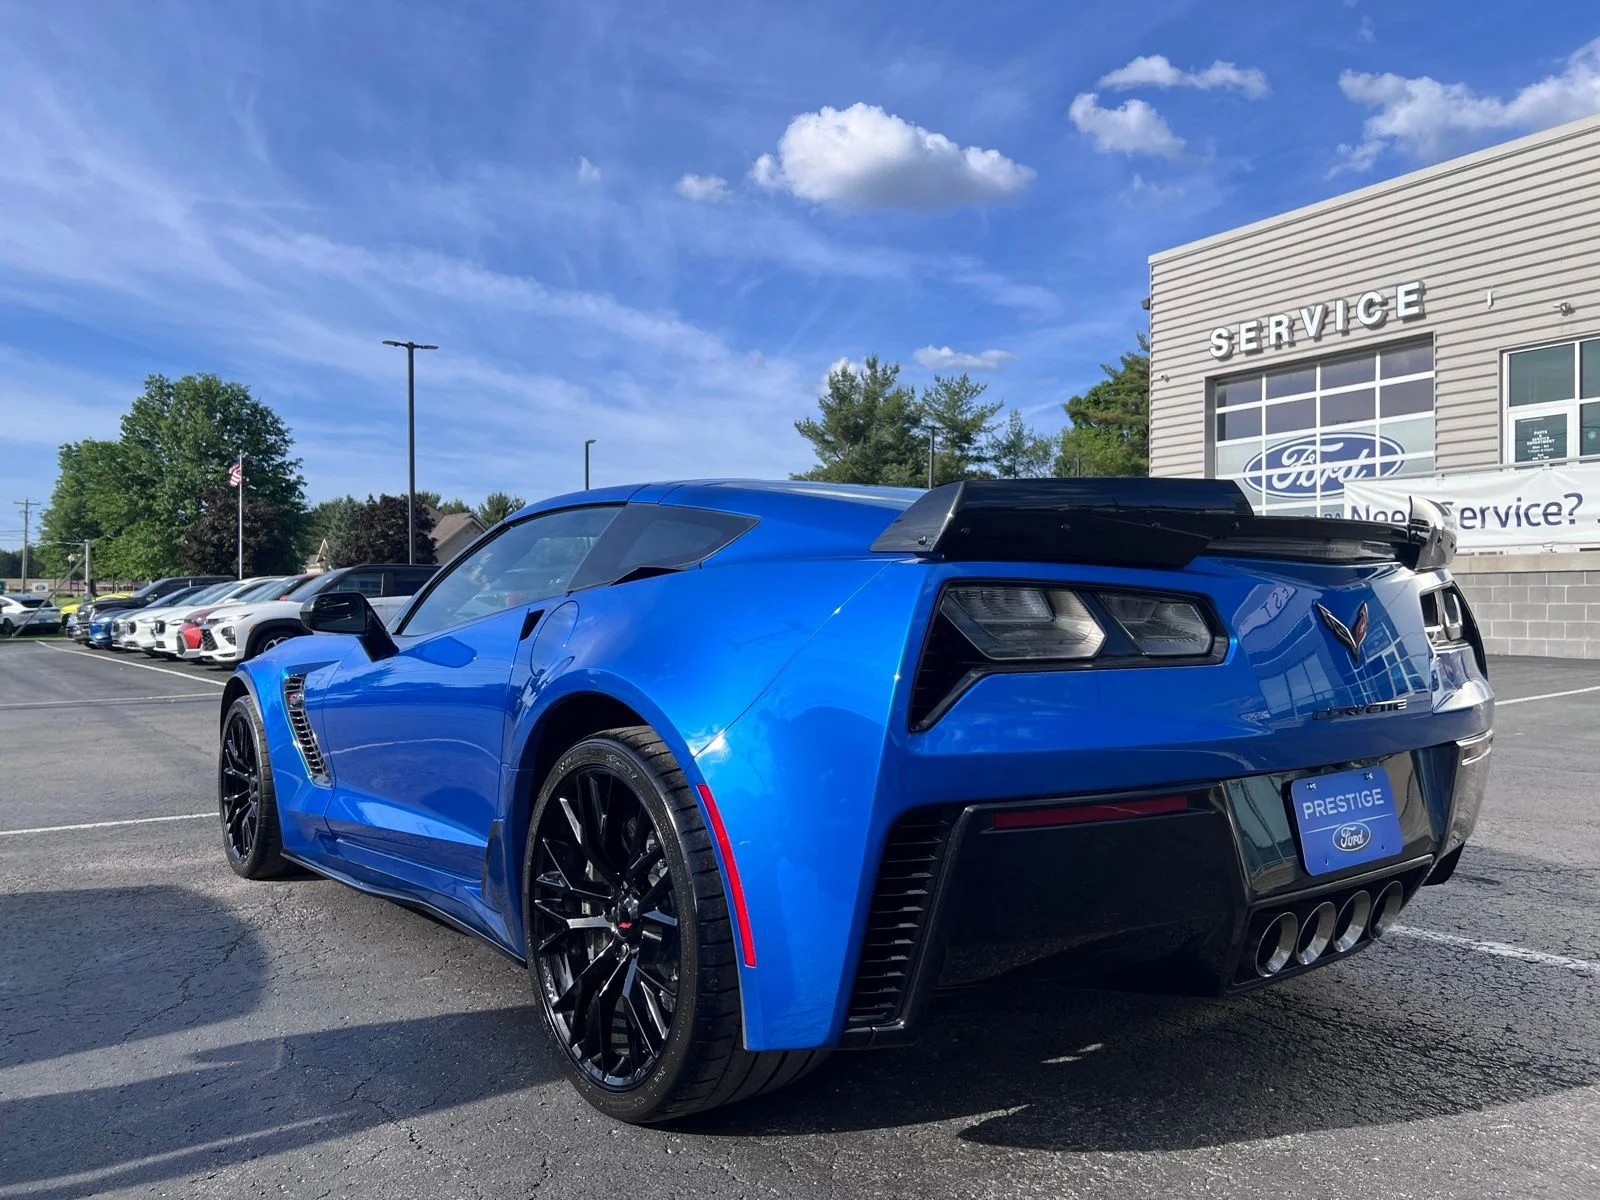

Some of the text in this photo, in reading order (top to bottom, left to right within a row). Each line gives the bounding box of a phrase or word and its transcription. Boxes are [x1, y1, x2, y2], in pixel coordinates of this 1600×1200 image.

[1209, 280, 1426, 360] SERVICE
[1271, 441, 1370, 490] Ford
[1440, 492, 1583, 530] ervice?
[1303, 788, 1384, 820] PRESTIGE
[1340, 826, 1365, 848] Ford
